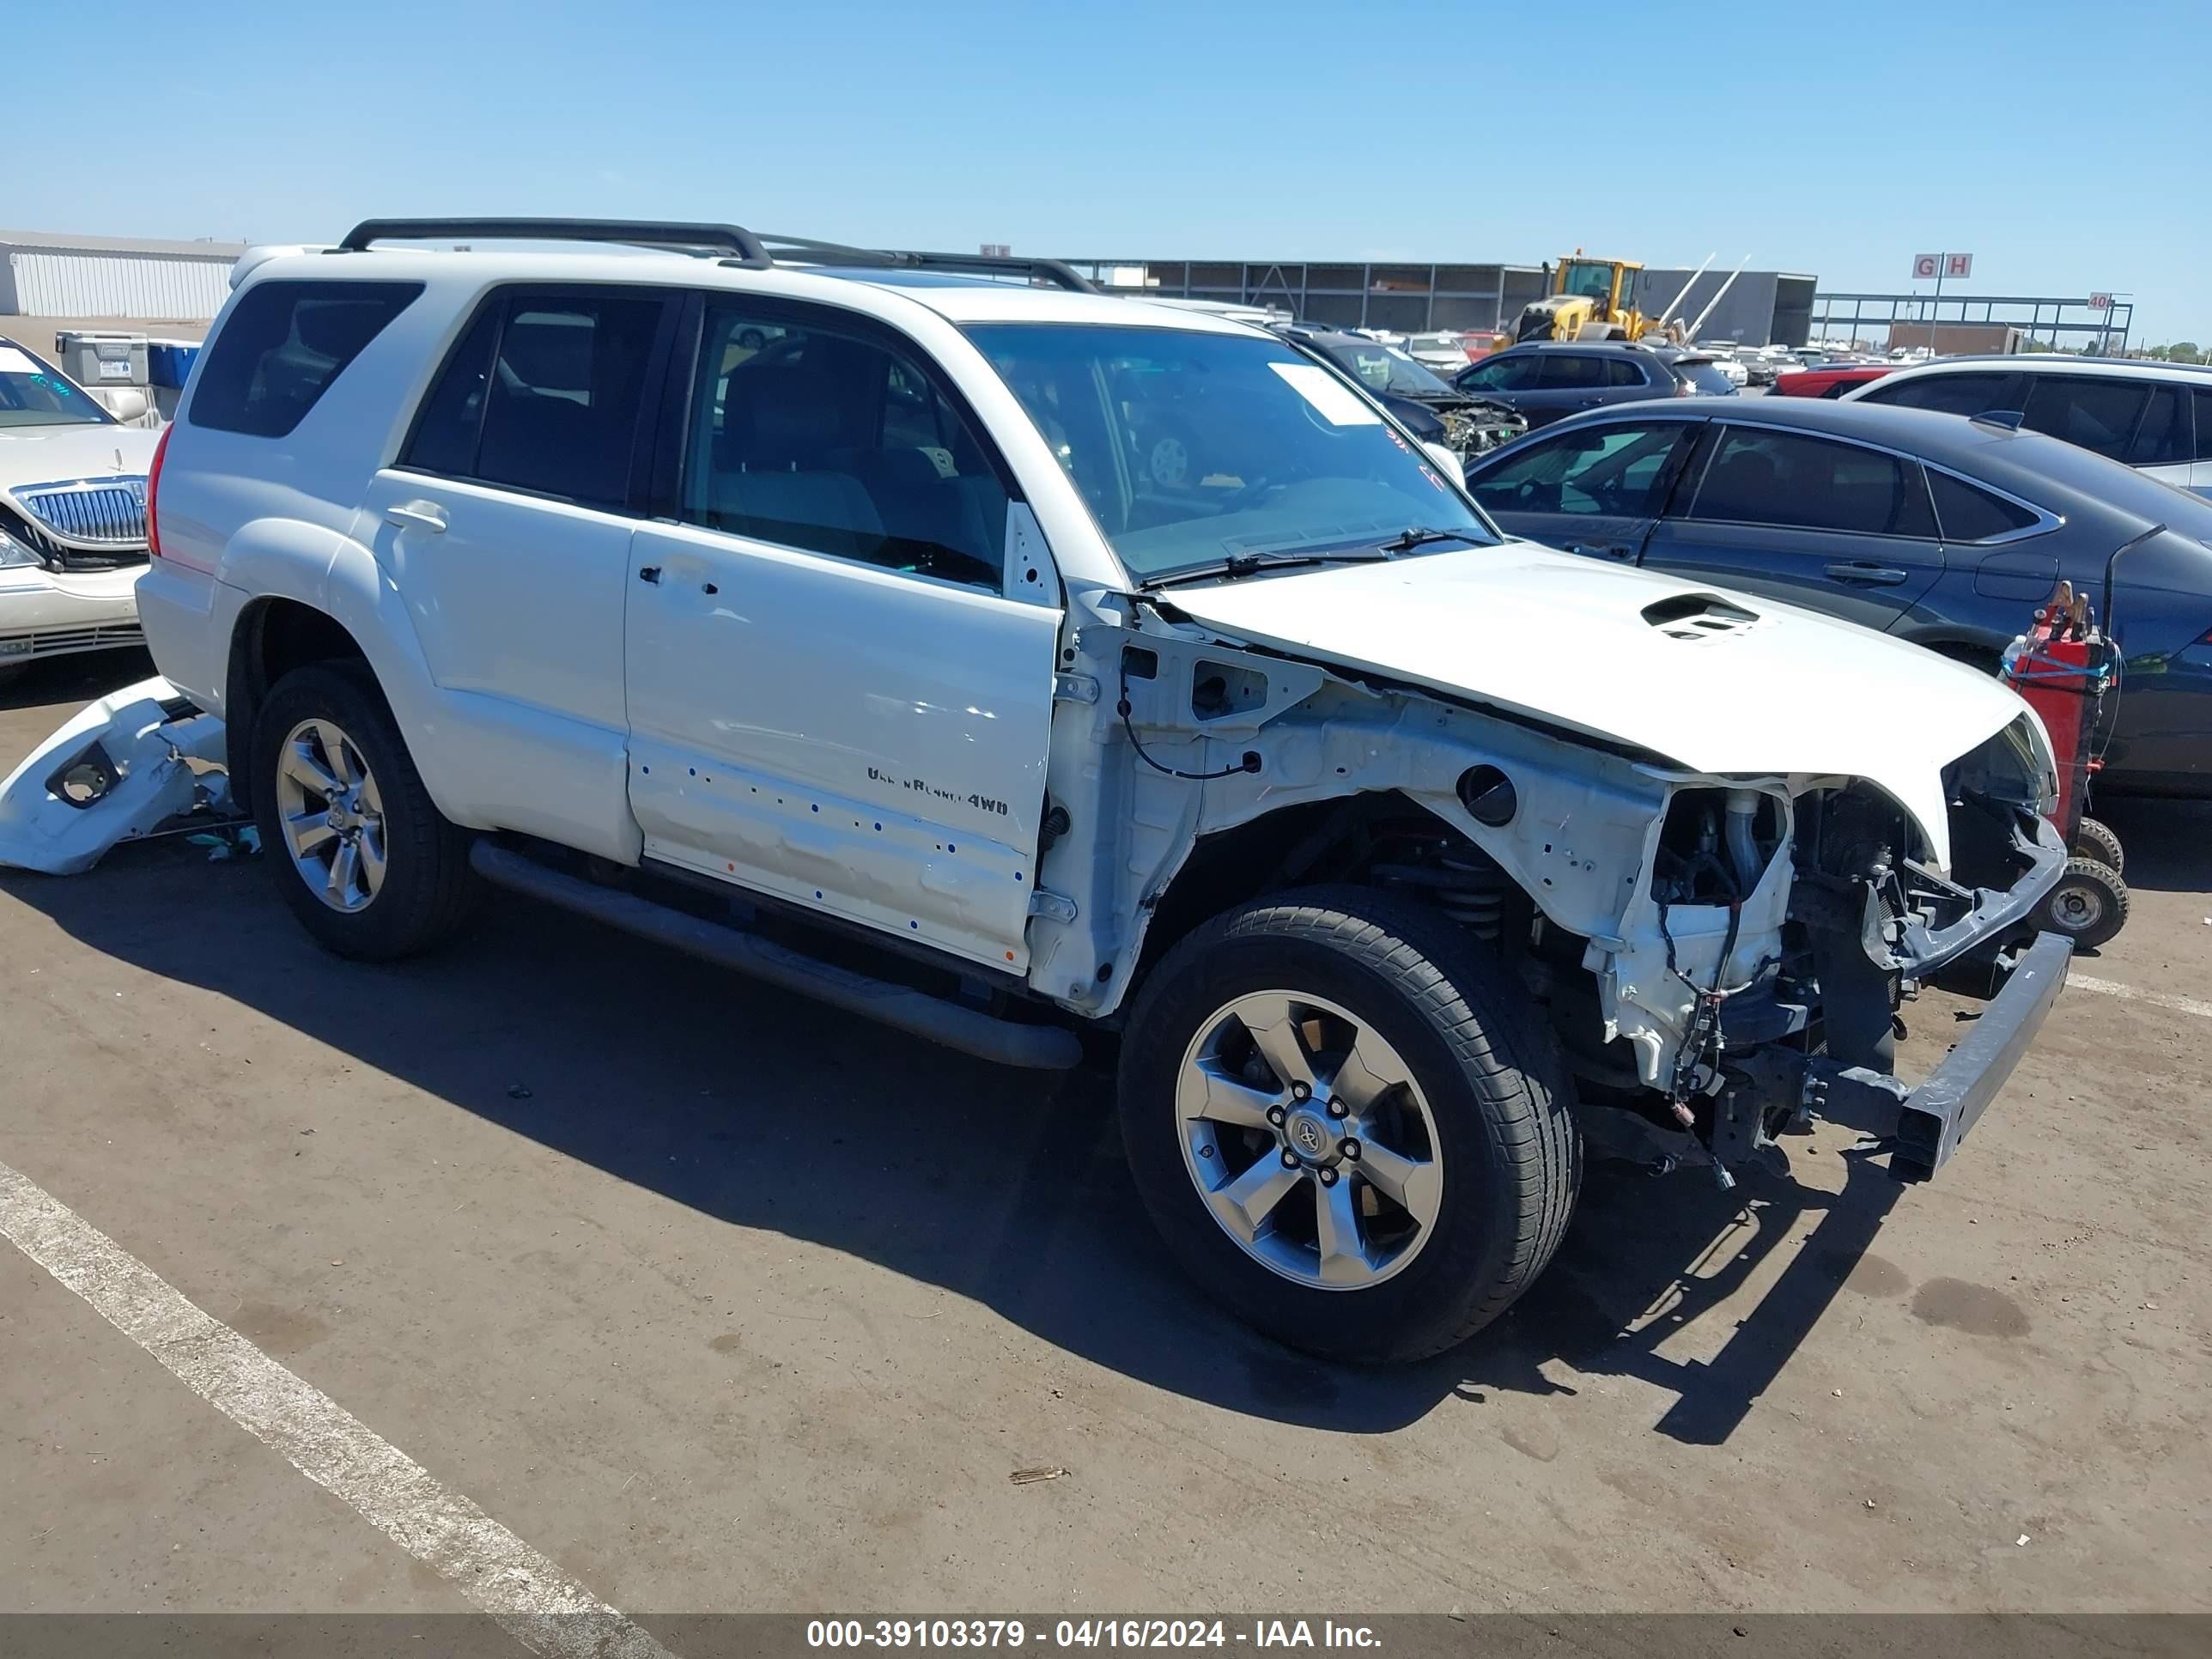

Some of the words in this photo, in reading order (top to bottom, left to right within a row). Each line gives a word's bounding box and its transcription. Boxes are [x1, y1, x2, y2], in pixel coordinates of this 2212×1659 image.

[1917, 258, 1935, 276] G
[1950, 257, 1966, 275] H
[968, 793, 1008, 817] 4WD
